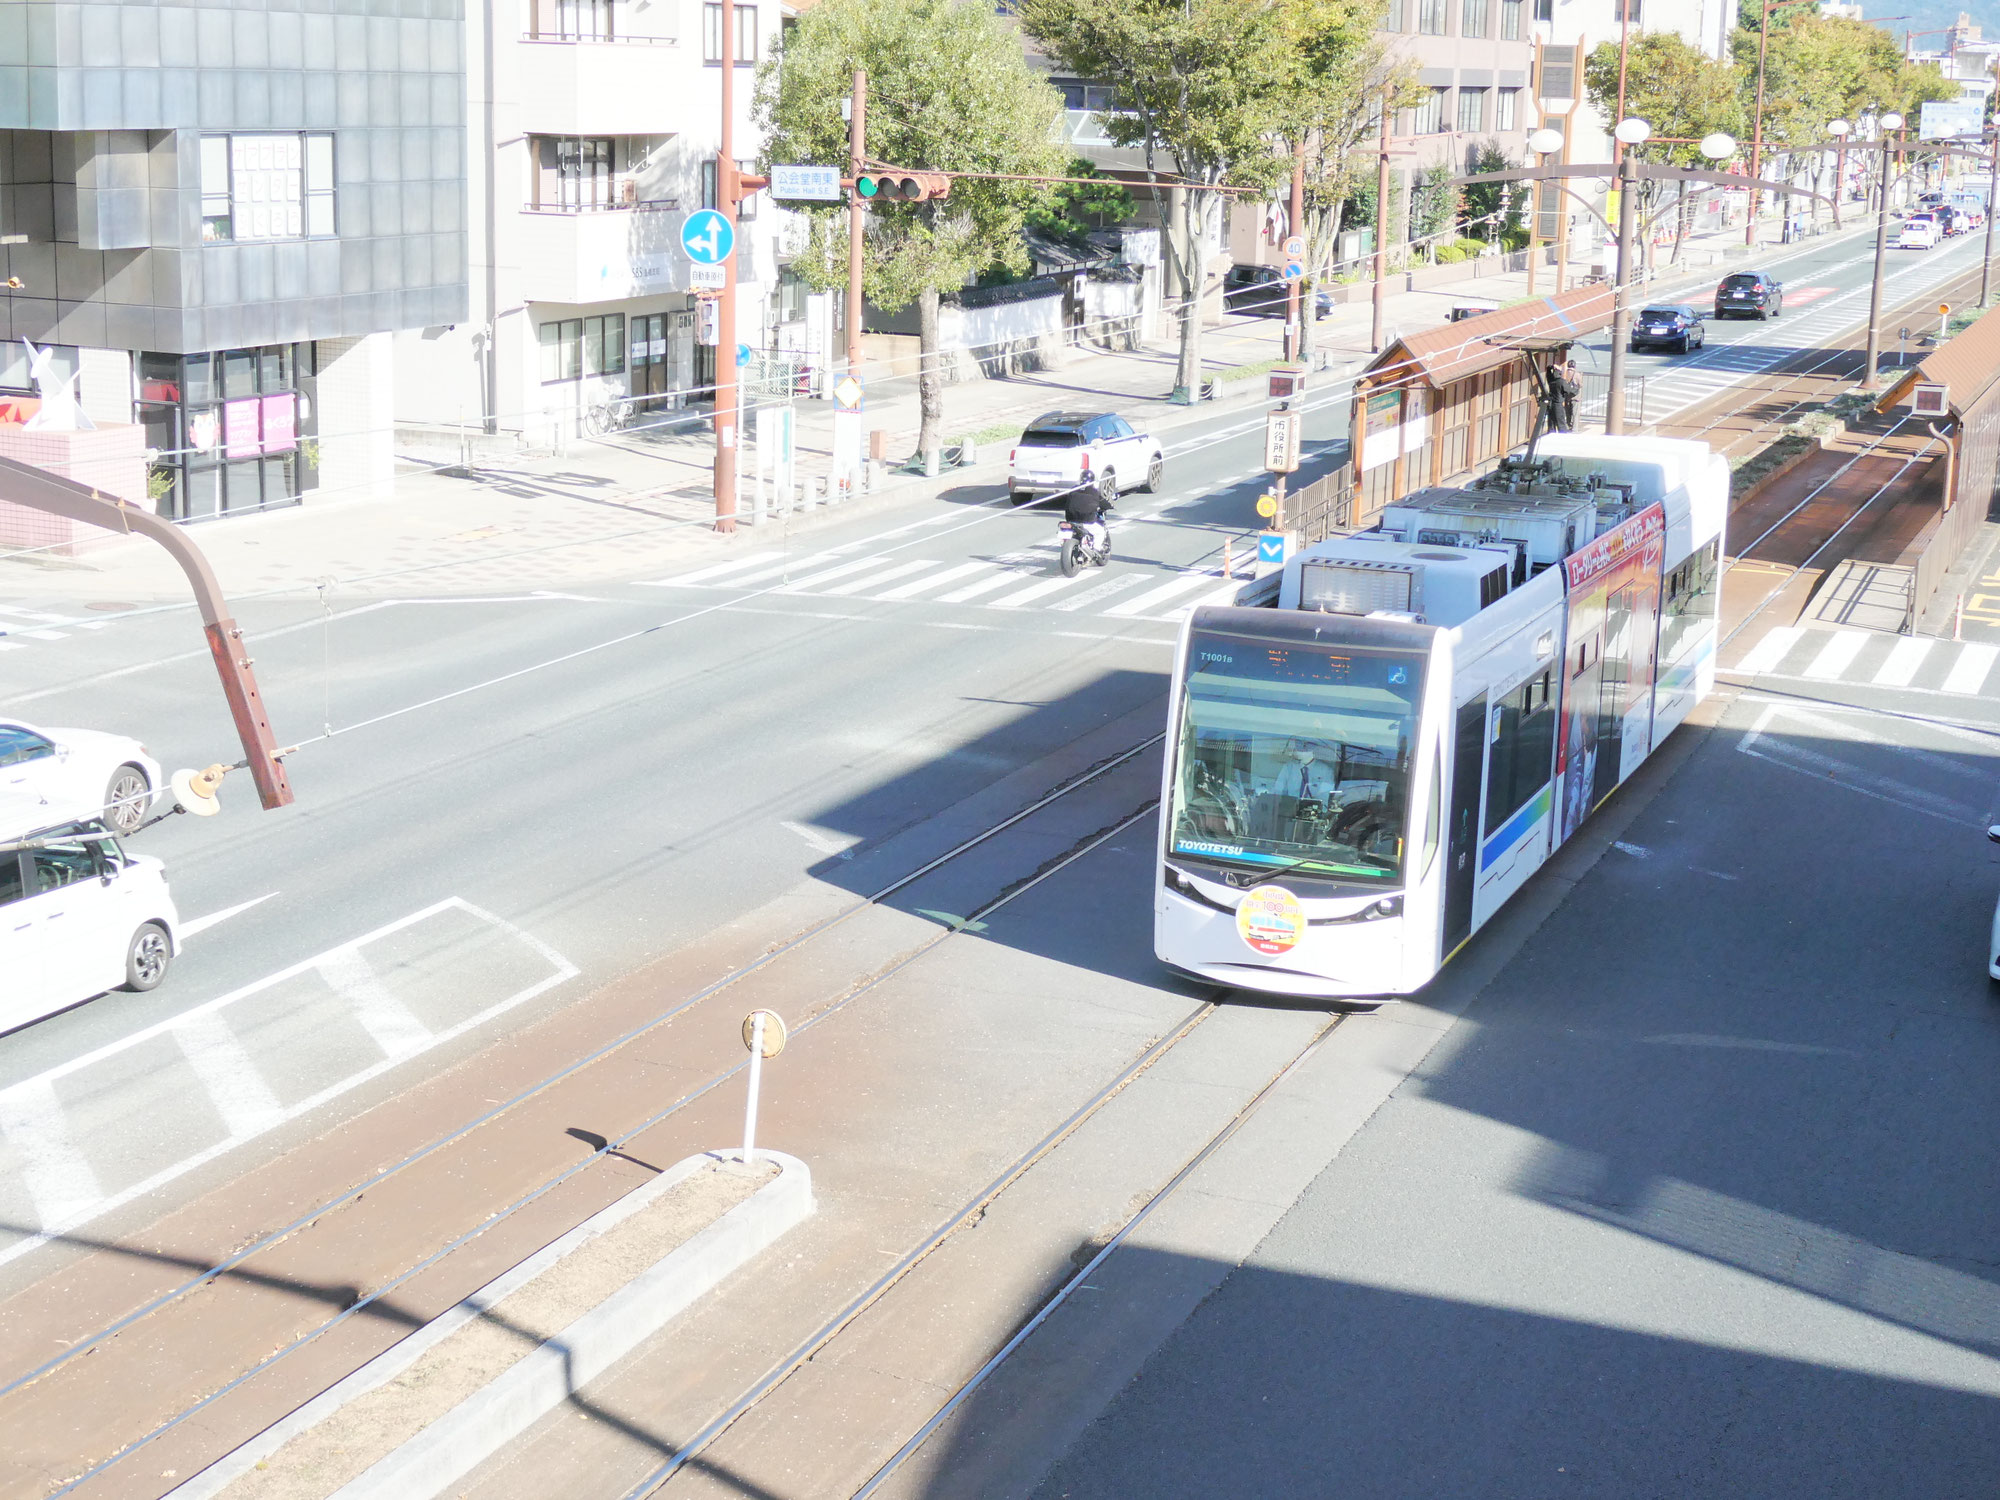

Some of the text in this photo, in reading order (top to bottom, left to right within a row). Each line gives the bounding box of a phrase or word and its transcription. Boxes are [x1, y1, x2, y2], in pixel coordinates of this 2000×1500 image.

[778, 172, 833, 186] 公会堂南東
[803, 187, 816, 195] Hall
[1288, 243, 1301, 254] 40
[1273, 420, 1286, 466] 市役所前
[1179, 840, 1243, 856] TOYOTETSU
